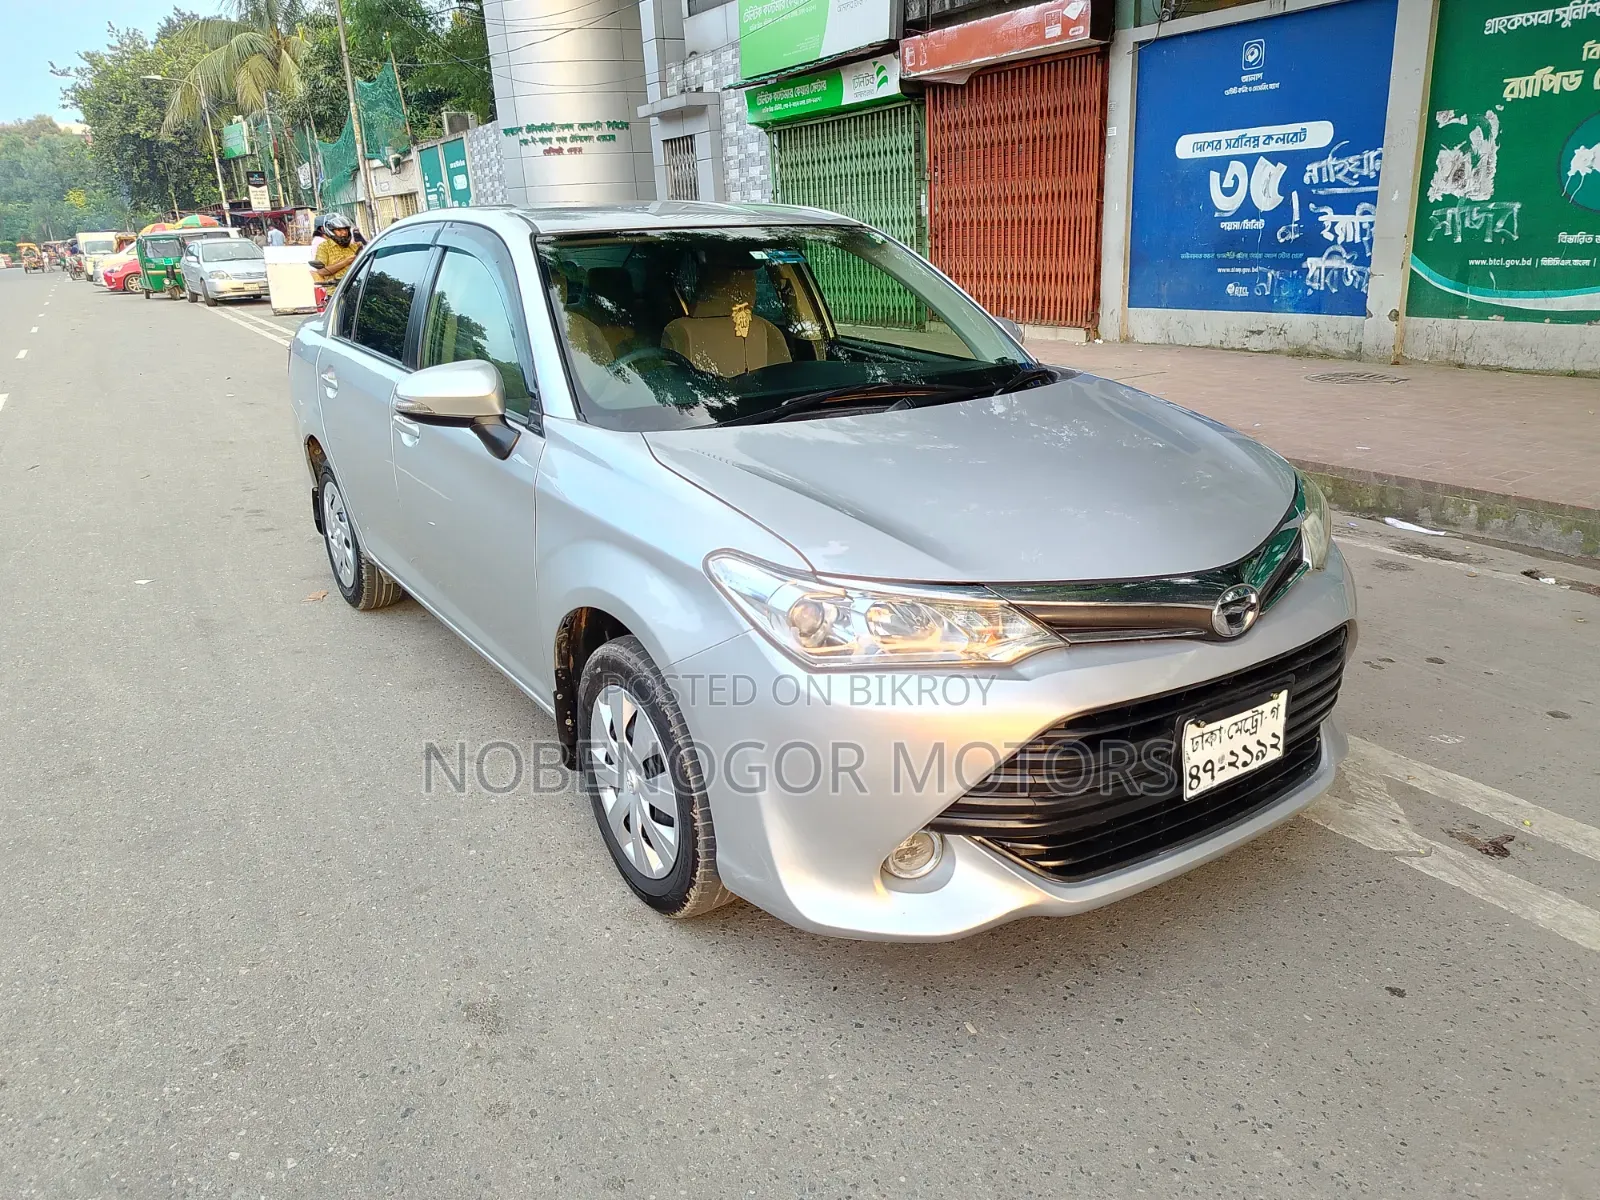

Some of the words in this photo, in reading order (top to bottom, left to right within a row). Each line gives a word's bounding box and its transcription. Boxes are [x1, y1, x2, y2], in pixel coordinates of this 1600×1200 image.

[1484, 9, 1554, 35] গ্রাহকসেবা
[1241, 72, 1264, 82] আলাপ
[1192, 138, 1222, 153] দেশের
[1224, 132, 1260, 151] সর্বনিম্ন
[1262, 127, 1307, 146] কলরেট
[1210, 155, 1287, 217] ৩৫
[1558, 231, 1594, 245] বিস্তারিত
[1468, 257, 1532, 268] www.btcl.gov.bd
[1191, 725, 1223, 753] ঢাকা
[1188, 732, 1281, 791] ৪৭-২১৯২
